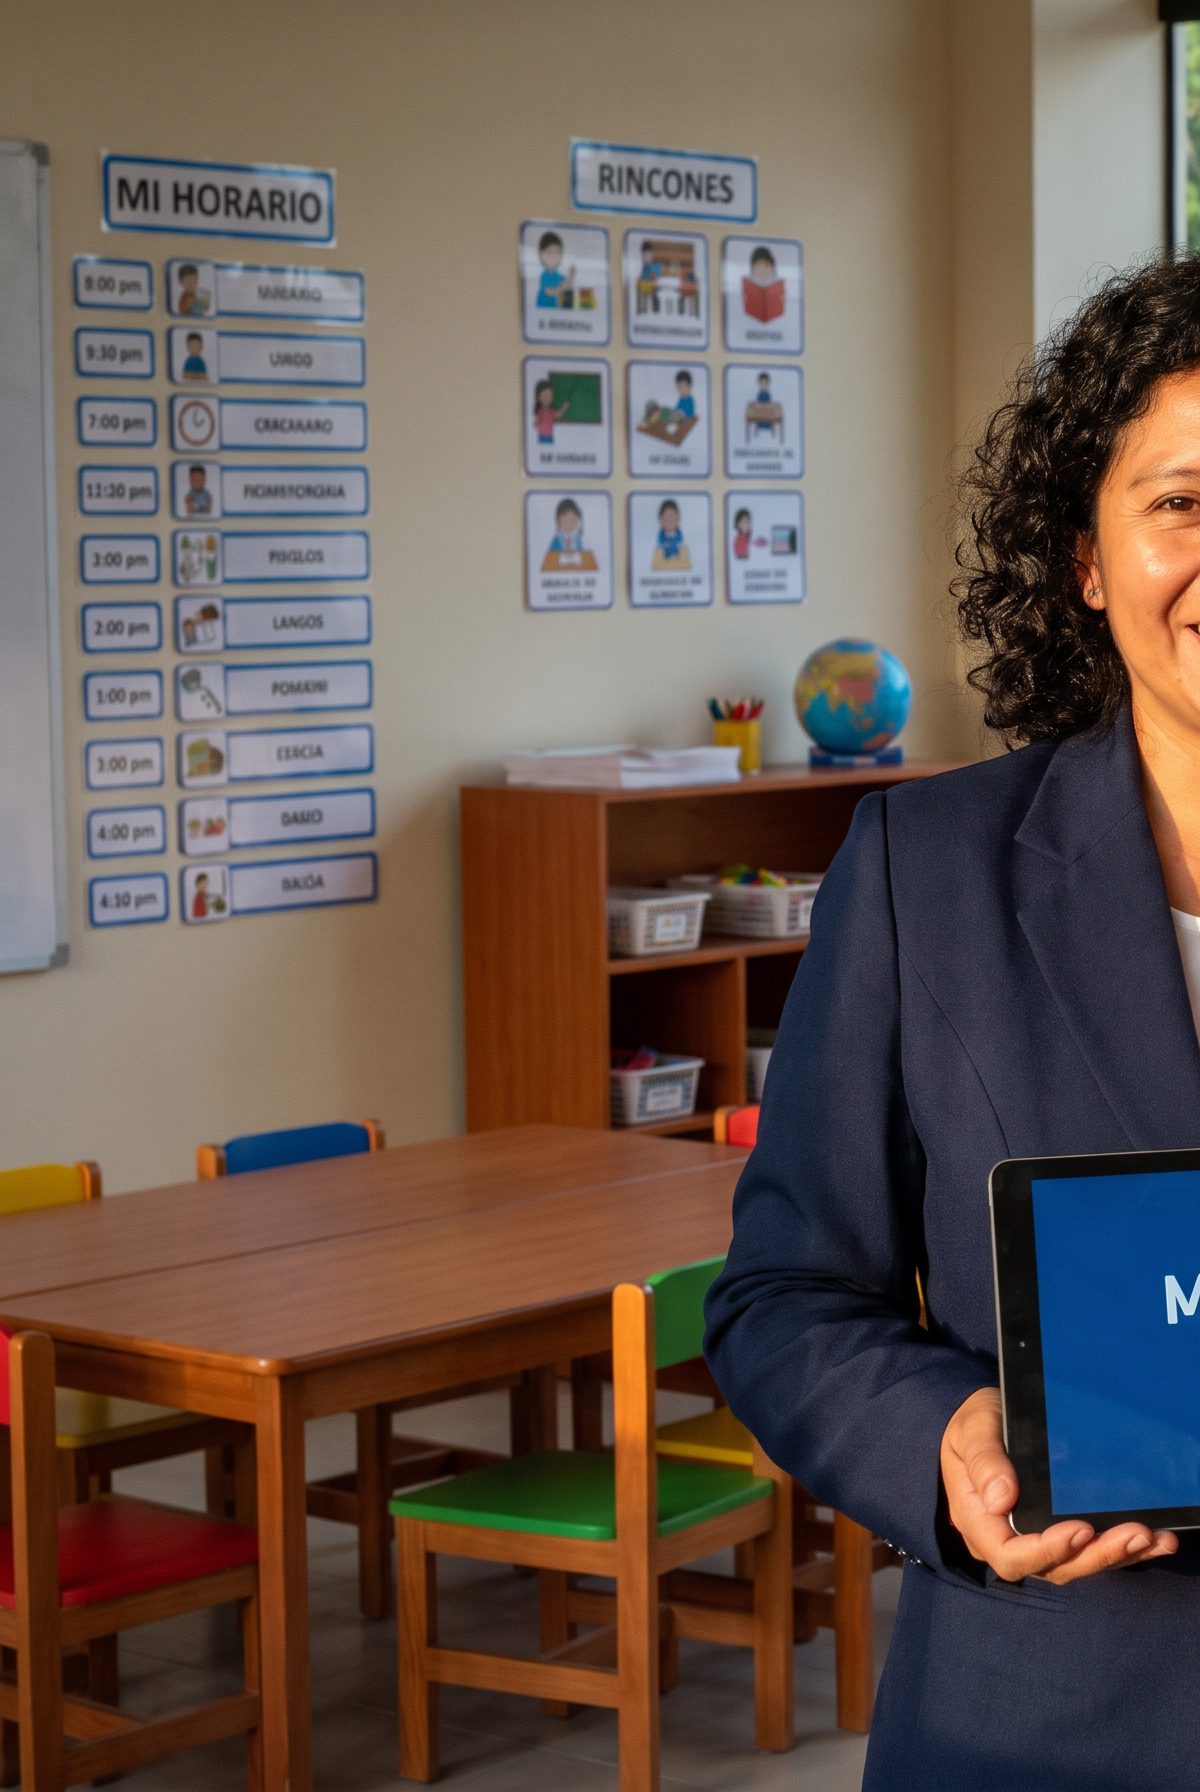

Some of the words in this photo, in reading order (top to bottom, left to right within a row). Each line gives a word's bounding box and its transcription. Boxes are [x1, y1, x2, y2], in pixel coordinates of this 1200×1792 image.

[598, 162, 735, 205] RINCONES
[117, 178, 160, 212] MI
[173, 182, 322, 225] HORARIO
[119, 280, 142, 295] pm
[119, 349, 143, 364] pm
[123, 418, 146, 432] pm
[129, 487, 152, 501] pm
[126, 555, 149, 570] pm
[95, 620, 124, 635] 2:00
[128, 623, 150, 637] pm
[129, 690, 151, 706] pm
[131, 758, 153, 773] pm
[97, 824, 129, 841] 4:00
[132, 826, 155, 842] pm
[134, 893, 157, 909] pm
